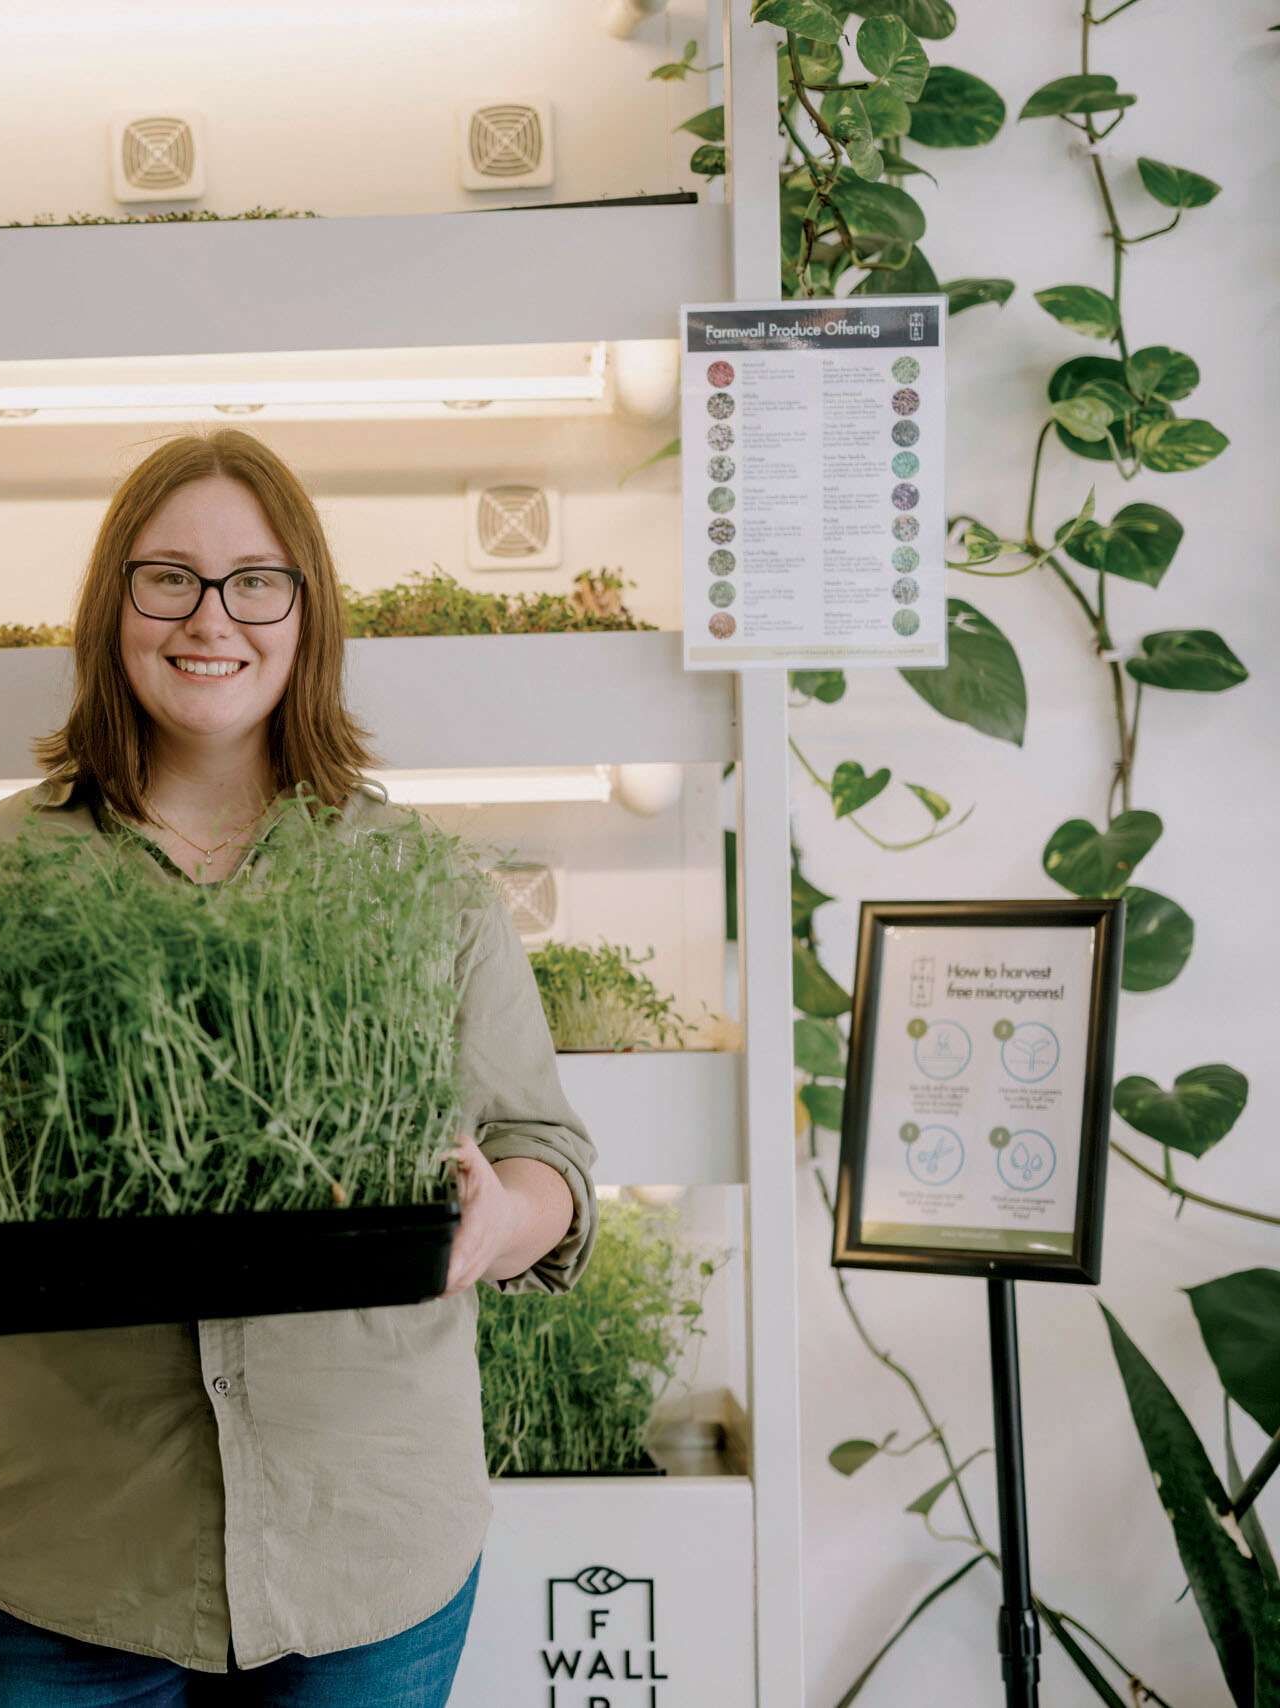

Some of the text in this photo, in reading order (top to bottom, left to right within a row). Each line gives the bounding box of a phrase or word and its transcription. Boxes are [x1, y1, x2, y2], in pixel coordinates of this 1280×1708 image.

[705, 320, 881, 340] Farmwall Produce Offering
[947, 962, 1052, 979] How to harvest
[946, 984, 1064, 1003] free microgreens!
[590, 1610, 609, 1639] F
[541, 1650, 668, 1680] WALL
